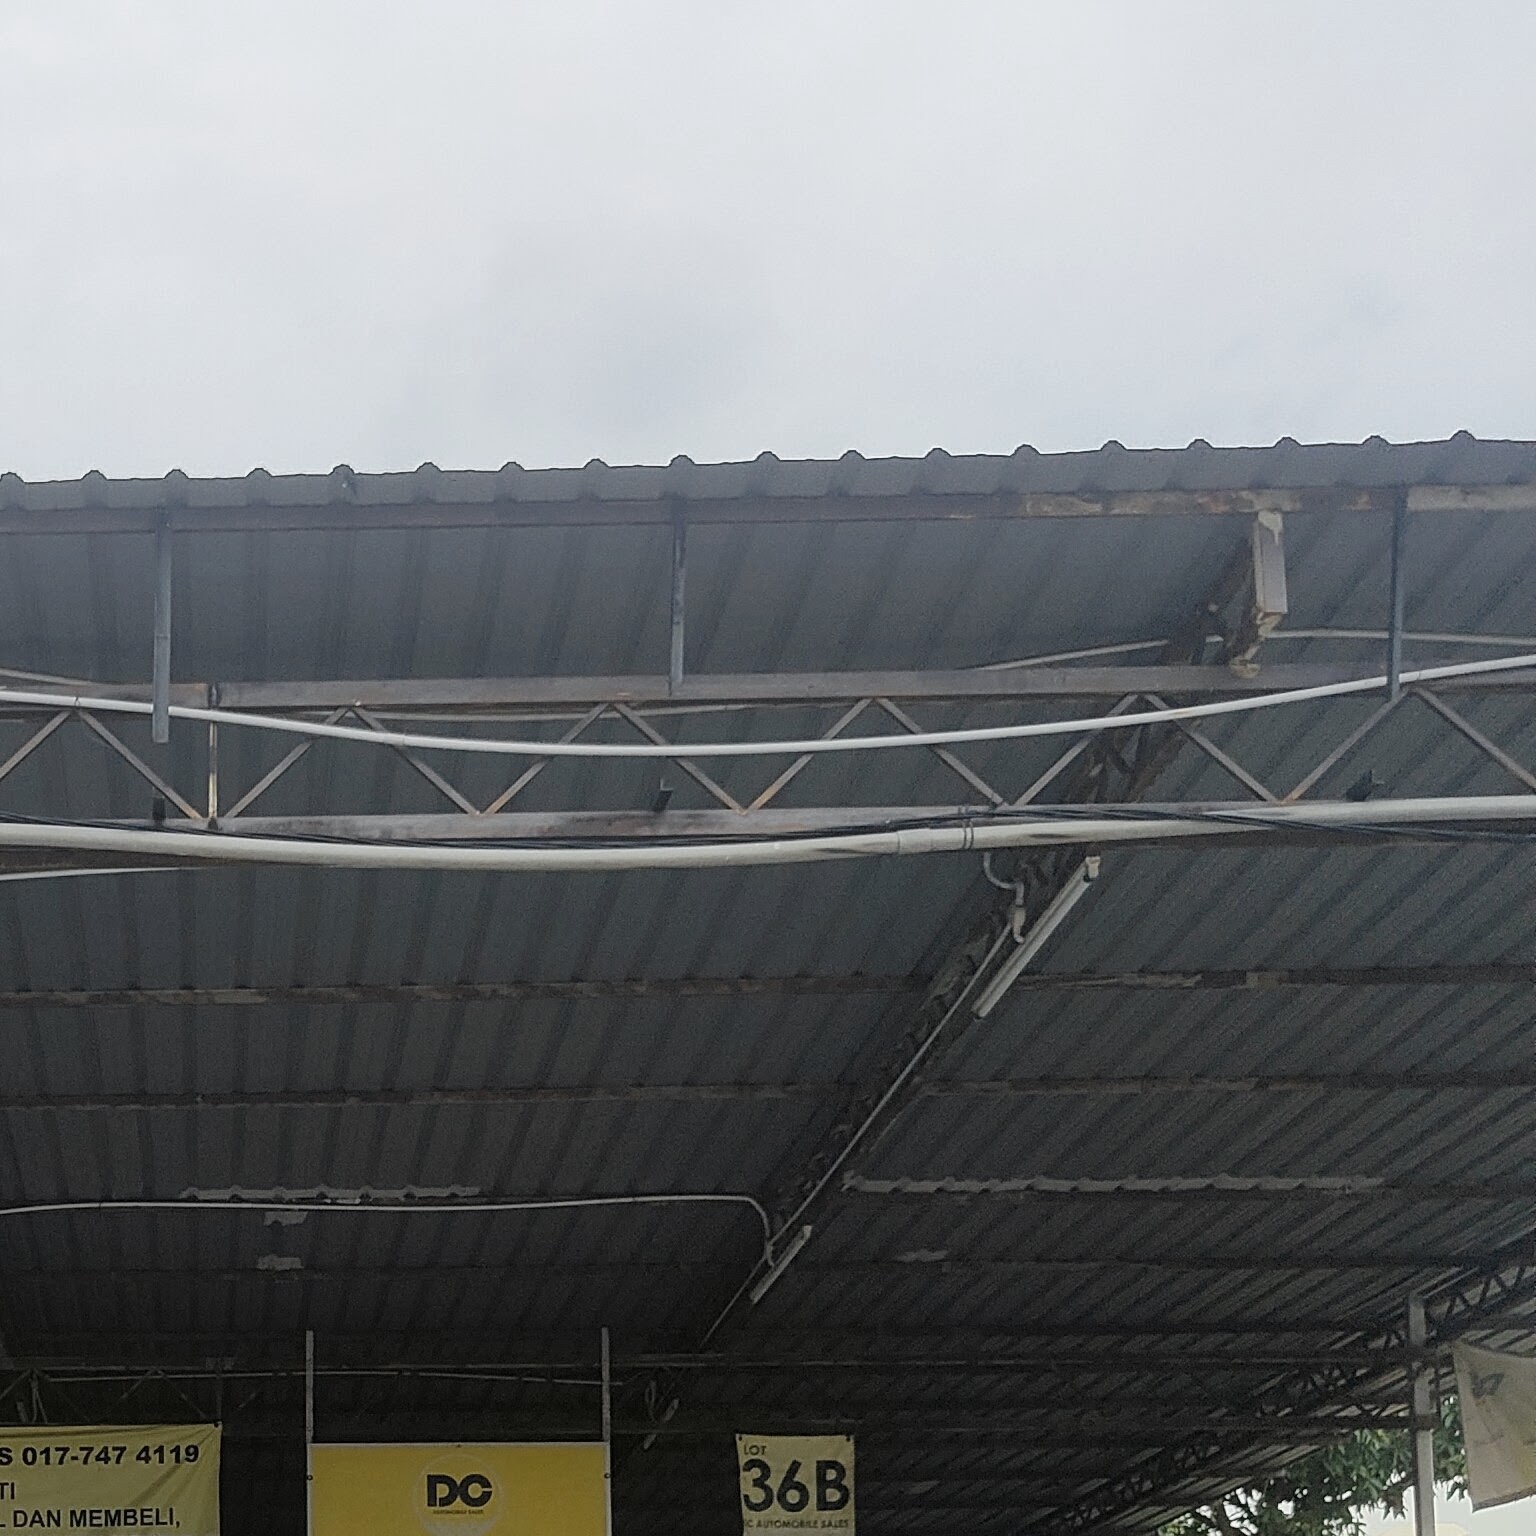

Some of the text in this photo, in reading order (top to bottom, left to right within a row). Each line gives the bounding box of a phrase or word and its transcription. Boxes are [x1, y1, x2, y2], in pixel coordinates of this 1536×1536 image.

[22, 1446, 127, 1466] 017-747
[136, 1444, 199, 1464] 4119
[744, 1444, 767, 1456] LOT
[427, 1474, 493, 1507] DC
[743, 1458, 850, 1512] 36B
[13, 1509, 61, 1528] DAN
[69, 1507, 180, 1529] MEMBELI,
